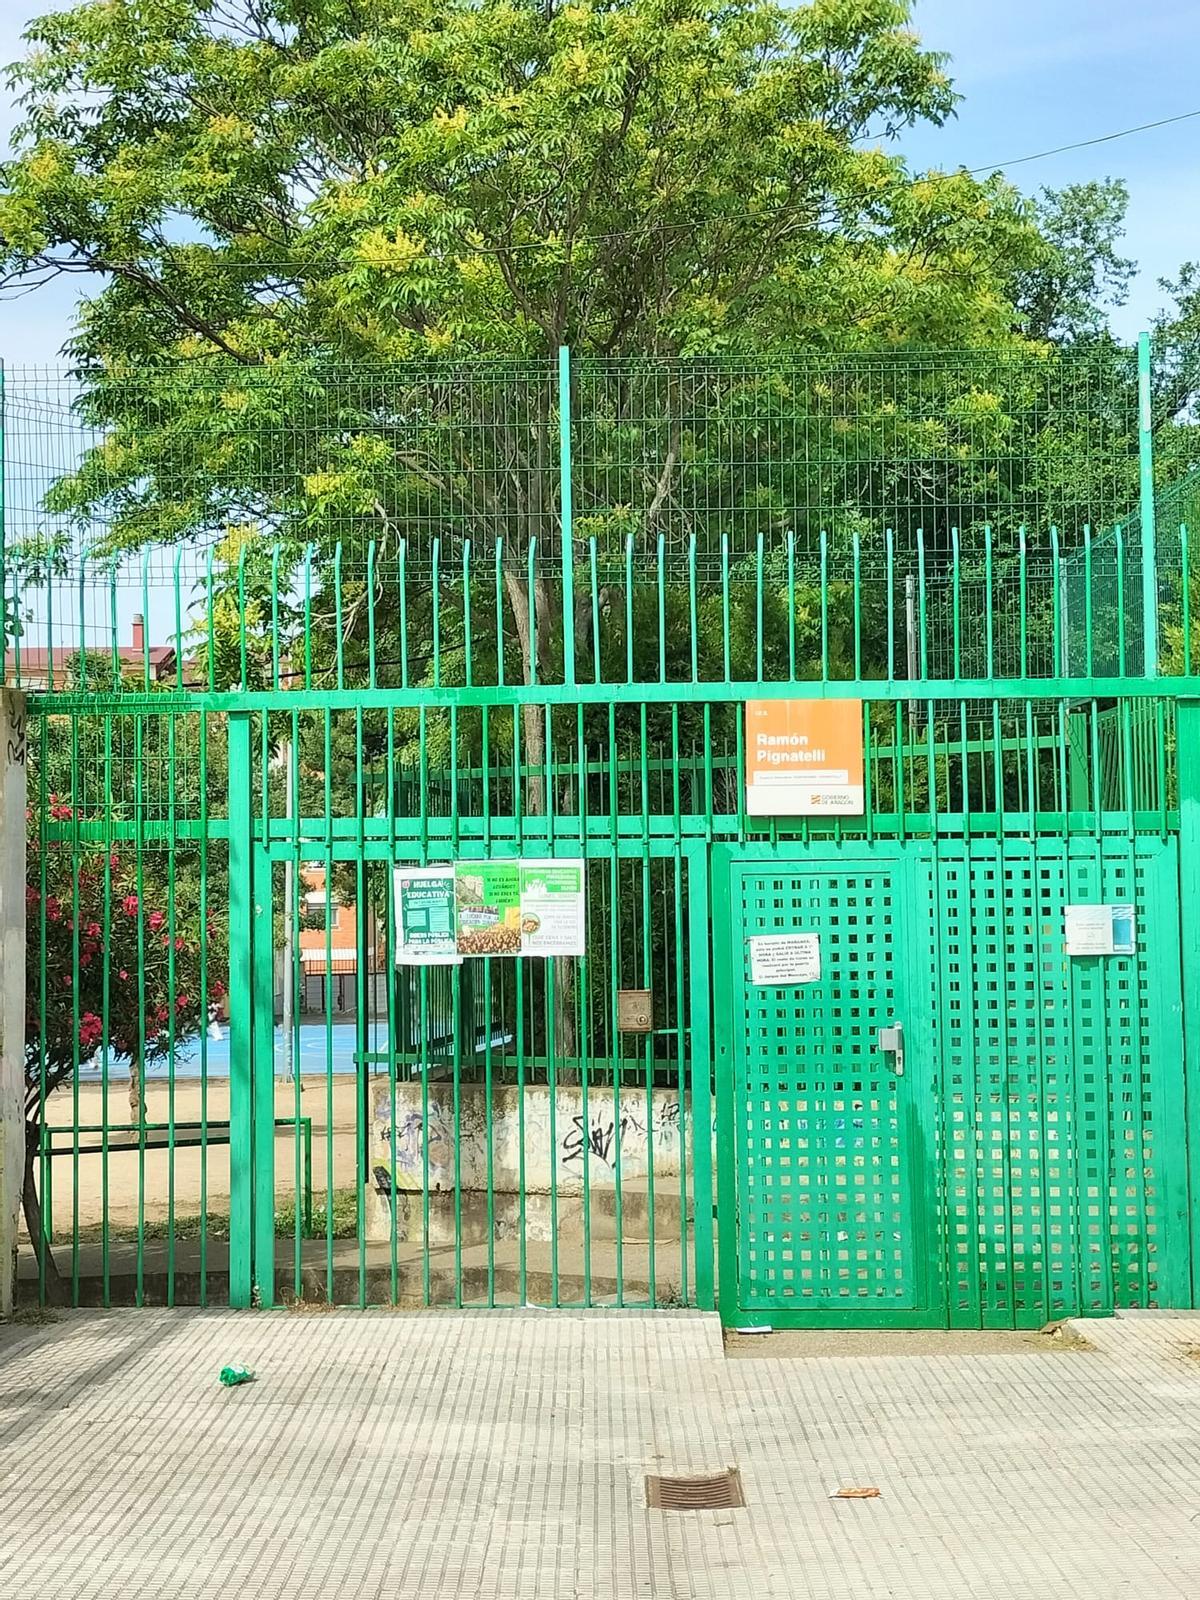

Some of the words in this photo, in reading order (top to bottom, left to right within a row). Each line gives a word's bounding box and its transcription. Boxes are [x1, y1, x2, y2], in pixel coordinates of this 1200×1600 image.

[756, 732, 808, 746] Ramón
[756, 749, 826, 765] Pignatelli
[413, 880, 443, 889] HUELGA
[407, 890, 450, 899] EDUCATIVA
